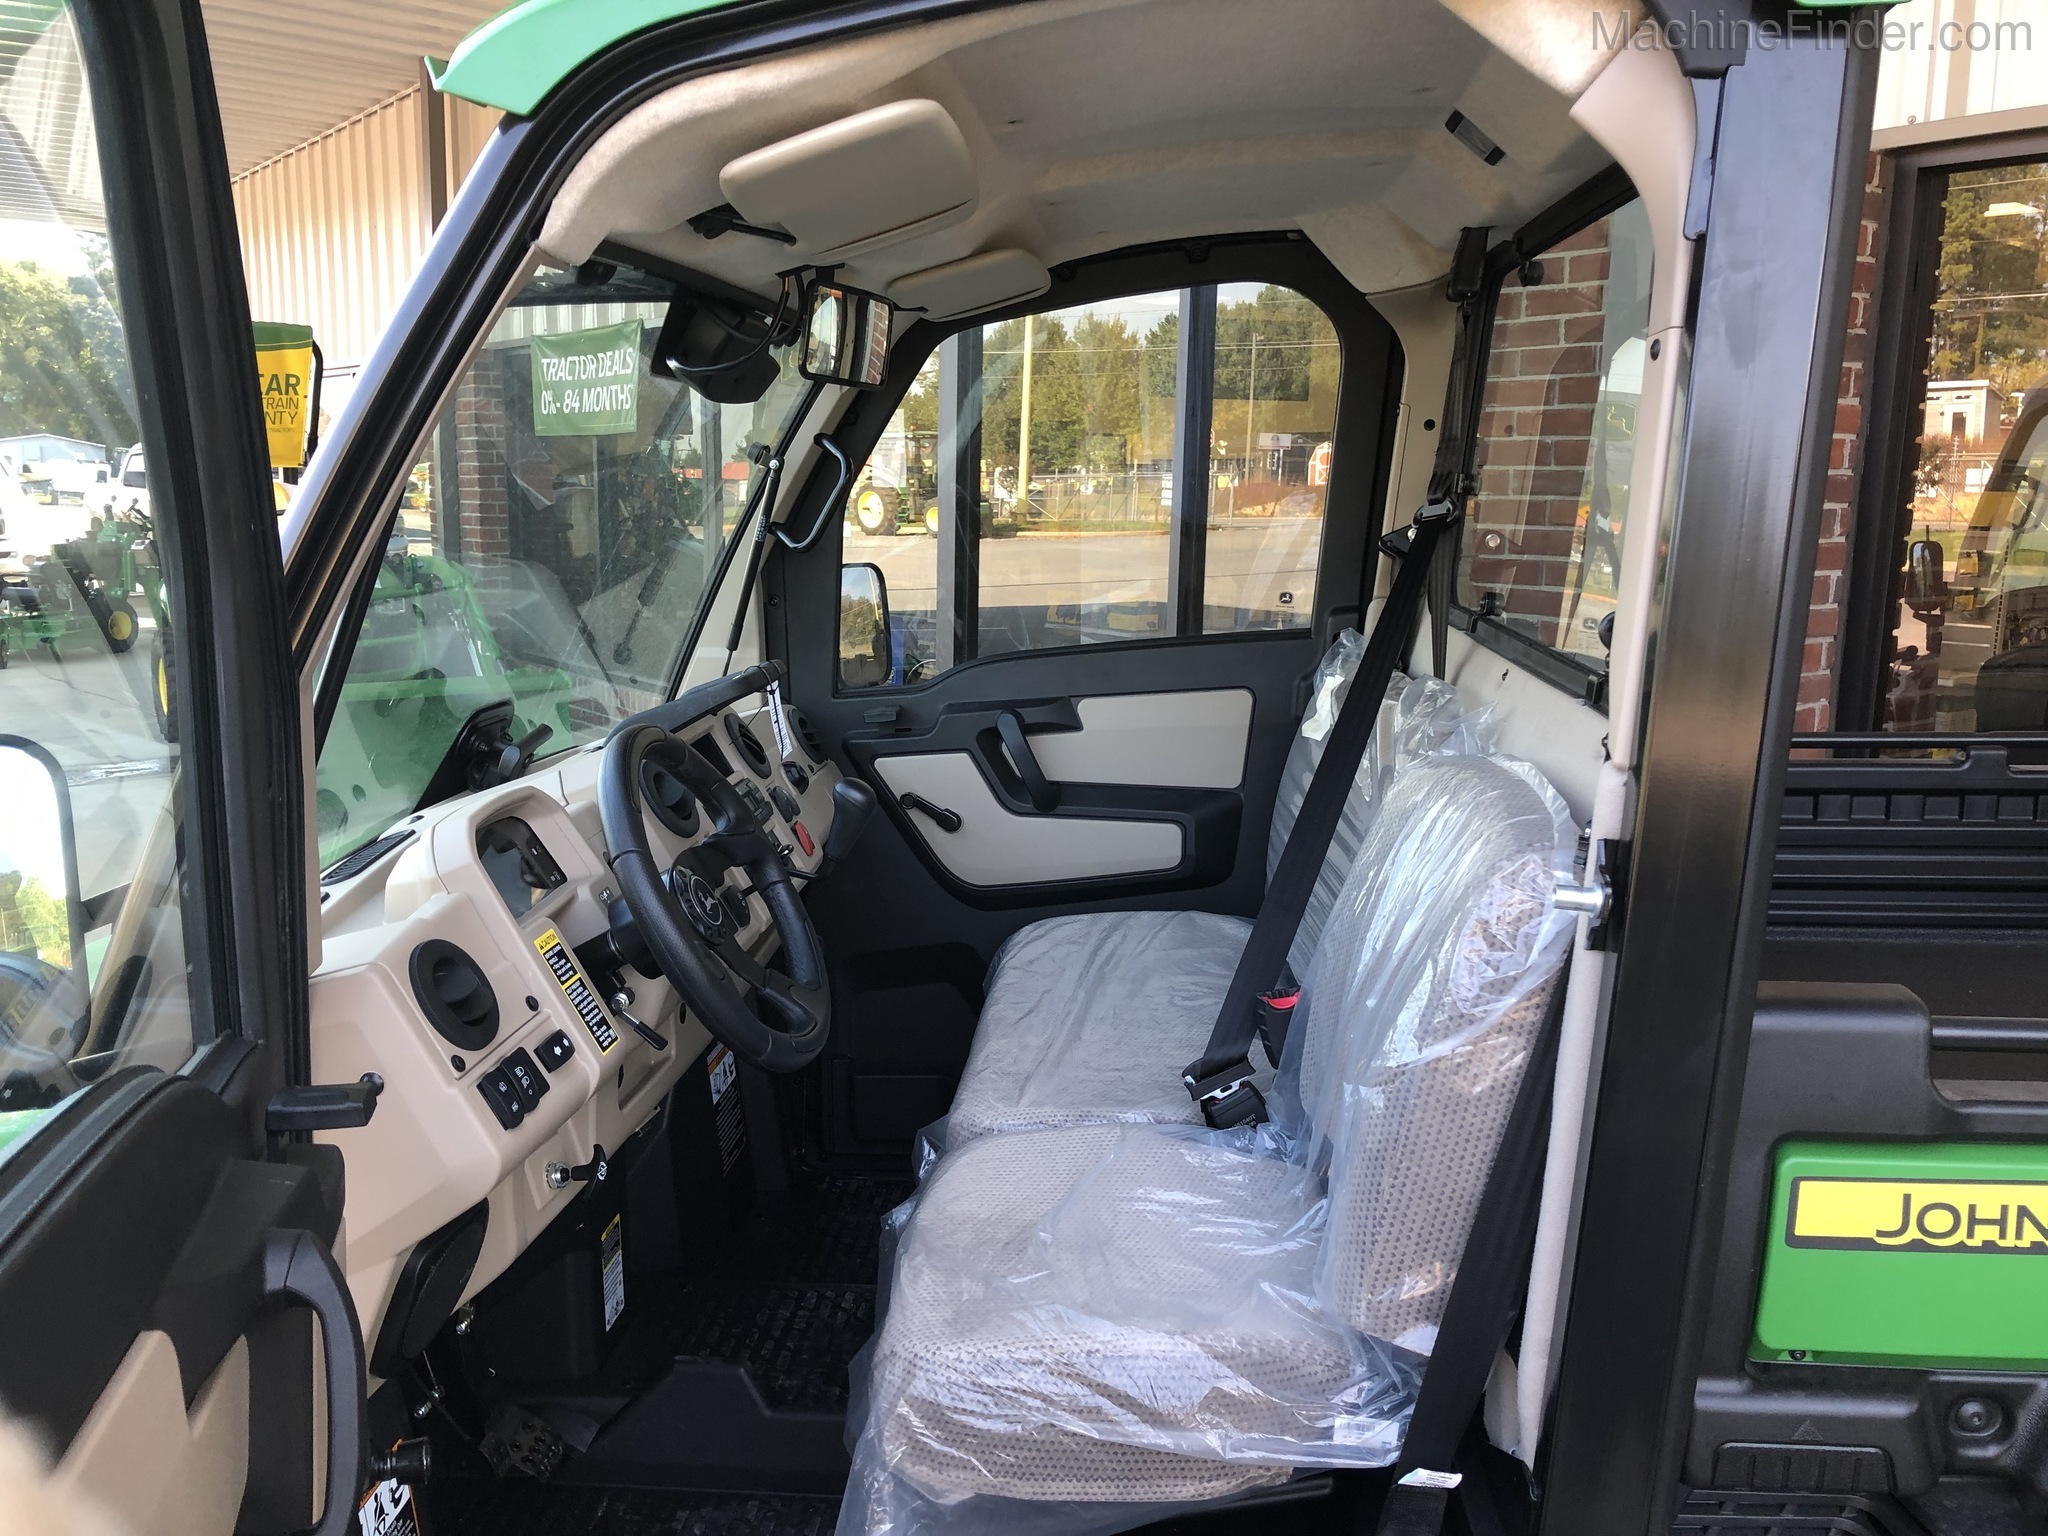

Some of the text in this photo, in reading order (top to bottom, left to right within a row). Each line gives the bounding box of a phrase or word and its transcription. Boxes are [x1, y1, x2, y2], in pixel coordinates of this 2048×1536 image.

[541, 347, 634, 382] TRACTOR DEALS
[259, 373, 301, 396] AR
[563, 388, 580, 414] 84
[1876, 1193, 2048, 1242] JOHN
